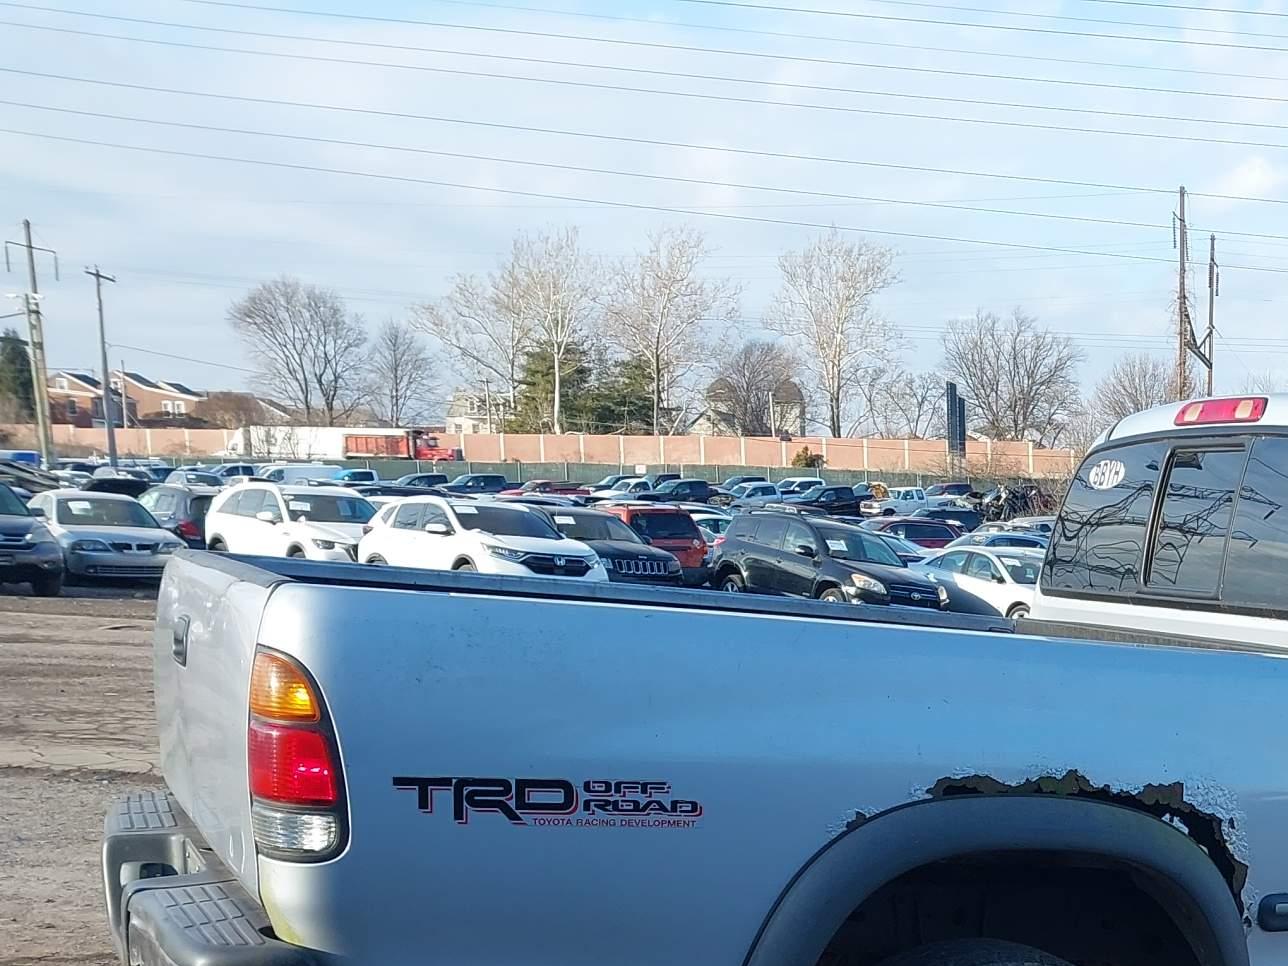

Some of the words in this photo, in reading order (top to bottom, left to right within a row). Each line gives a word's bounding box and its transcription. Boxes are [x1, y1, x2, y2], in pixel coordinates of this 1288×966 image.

[583, 780, 671, 797] OFF
[392, 776, 578, 825] TRD
[582, 799, 702, 816] ROAD
[532, 817, 573, 827] TOYOTA
[576, 818, 616, 828] RACING
[620, 819, 697, 829] DEVELOPMENT
